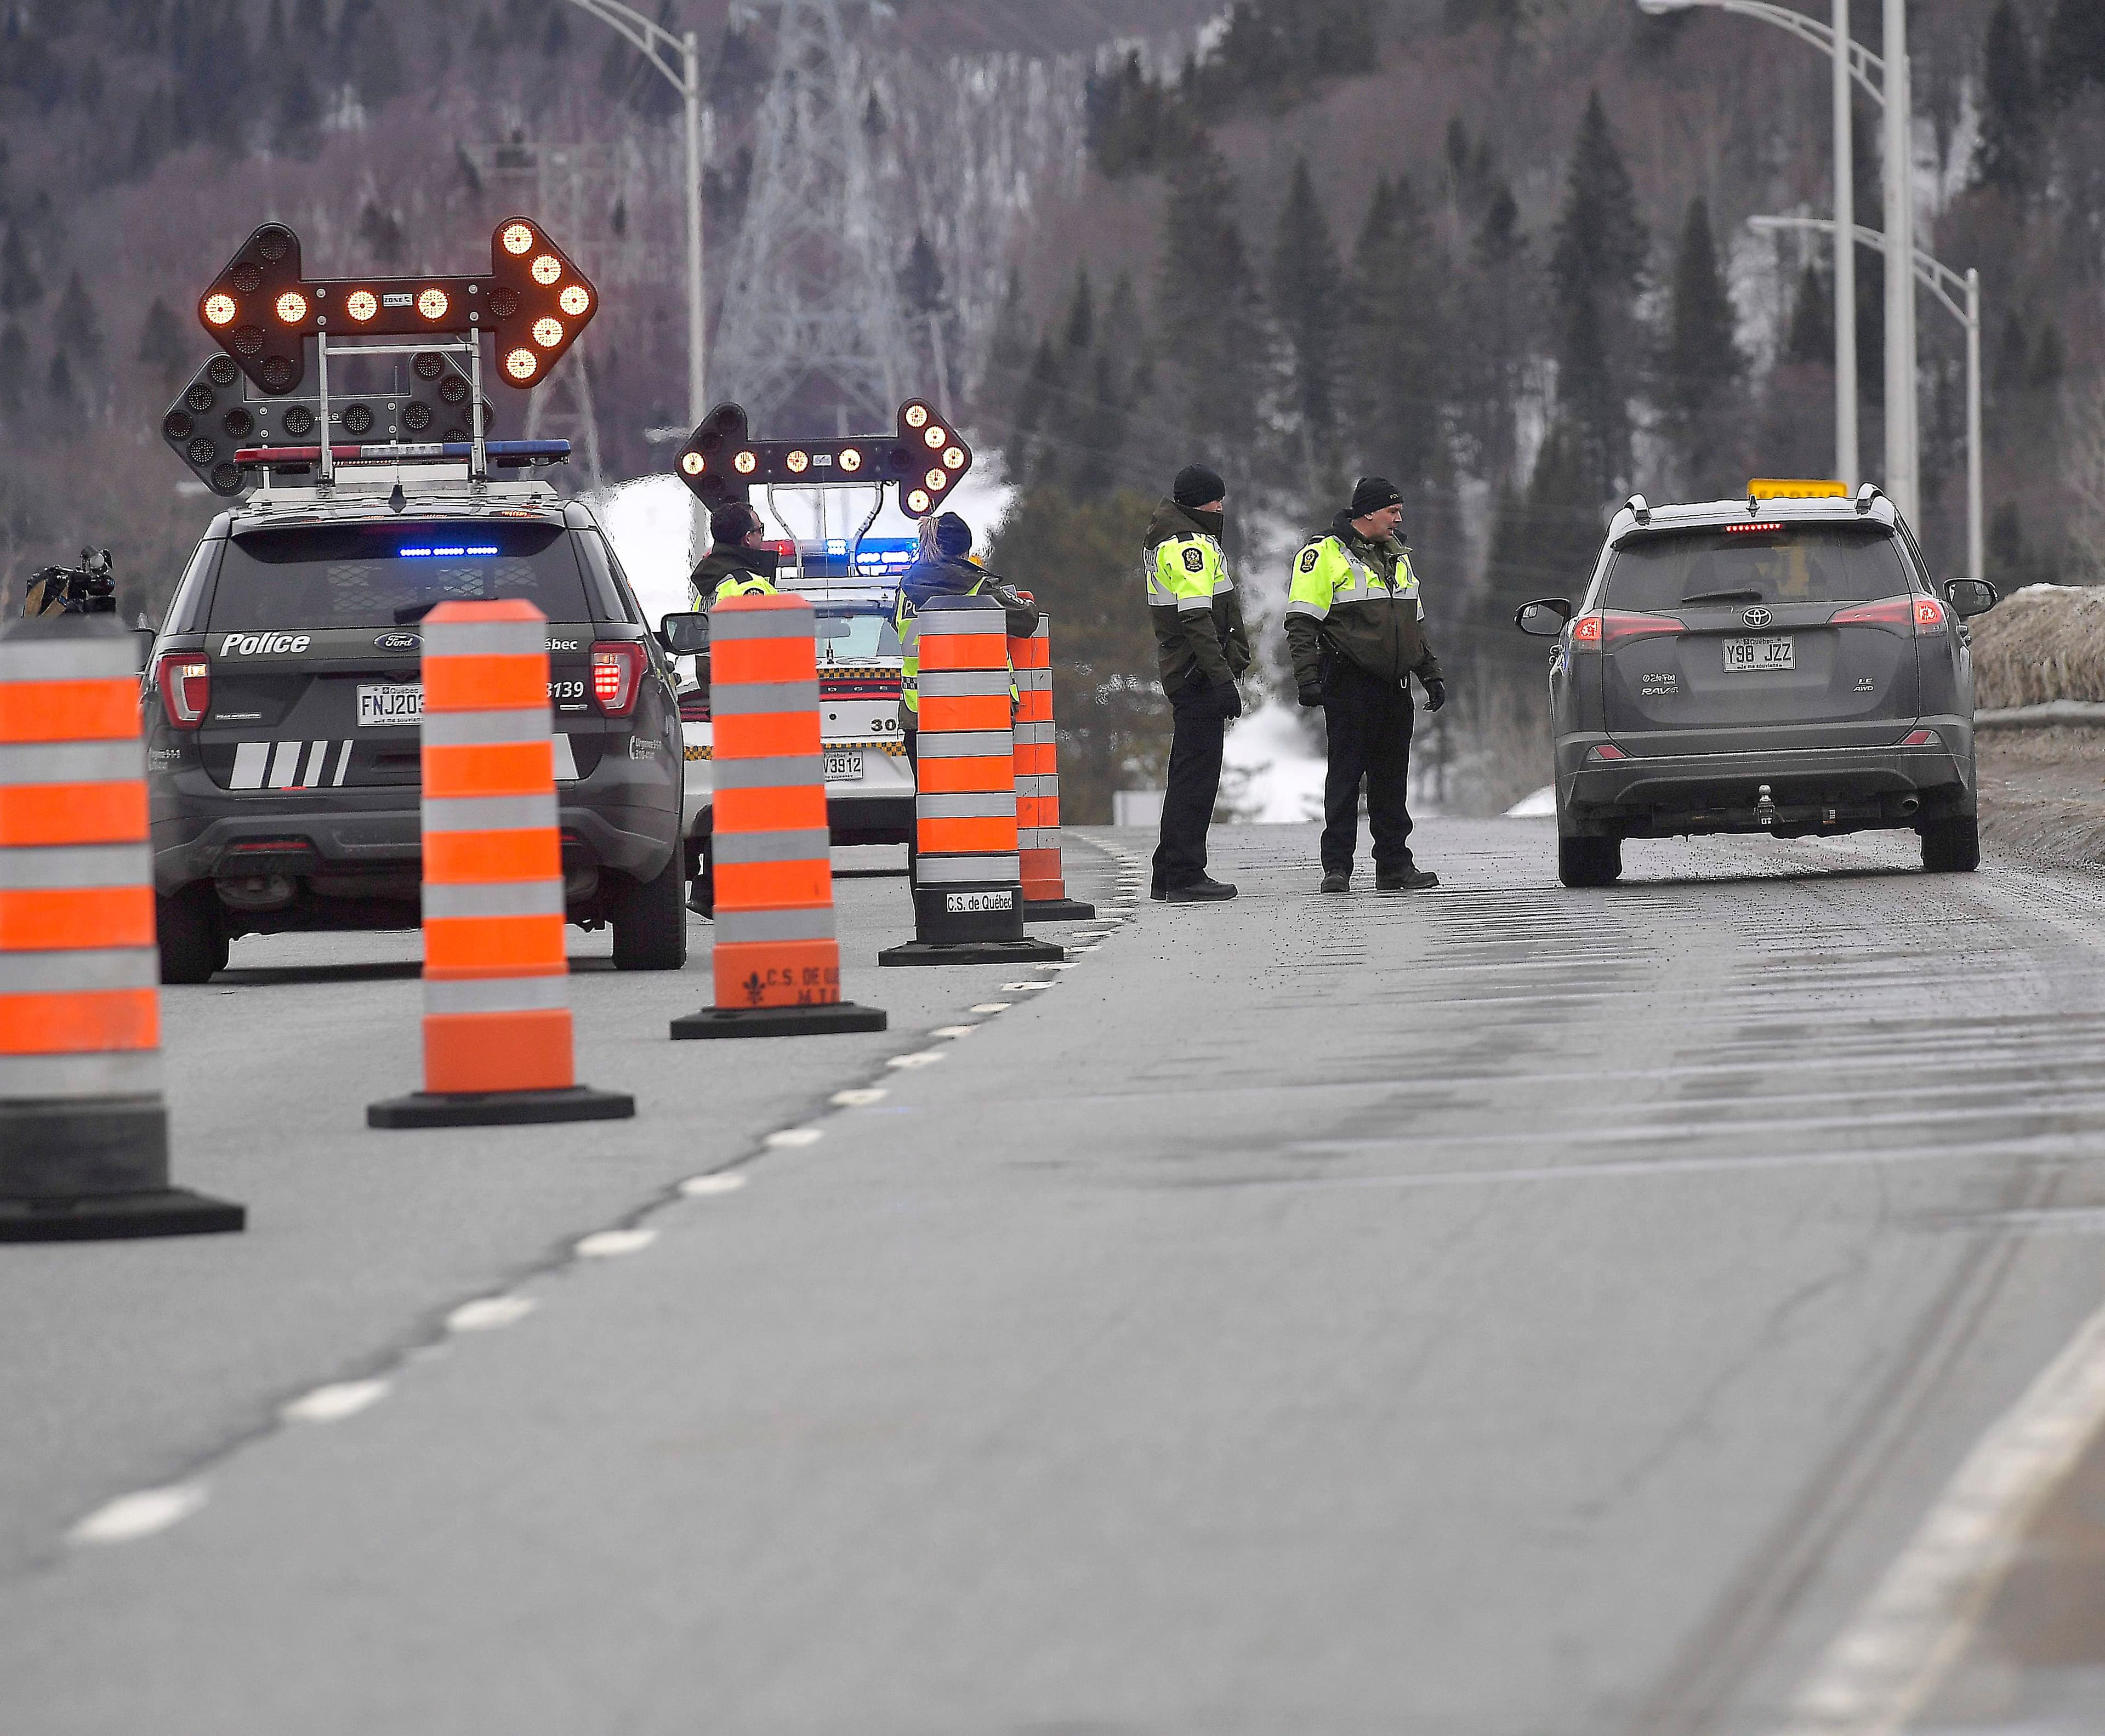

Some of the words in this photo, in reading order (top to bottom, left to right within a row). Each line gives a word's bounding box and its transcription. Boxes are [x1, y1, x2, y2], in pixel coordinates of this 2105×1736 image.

[219, 631, 311, 657] Police
[385, 635, 413, 647] Ford
[1764, 643, 1791, 661] JZZ
[1641, 686, 1679, 695] RAV4
[948, 896, 966, 911] C.S.
[968, 896, 980, 910] de
[982, 894, 1011, 909] Québec
